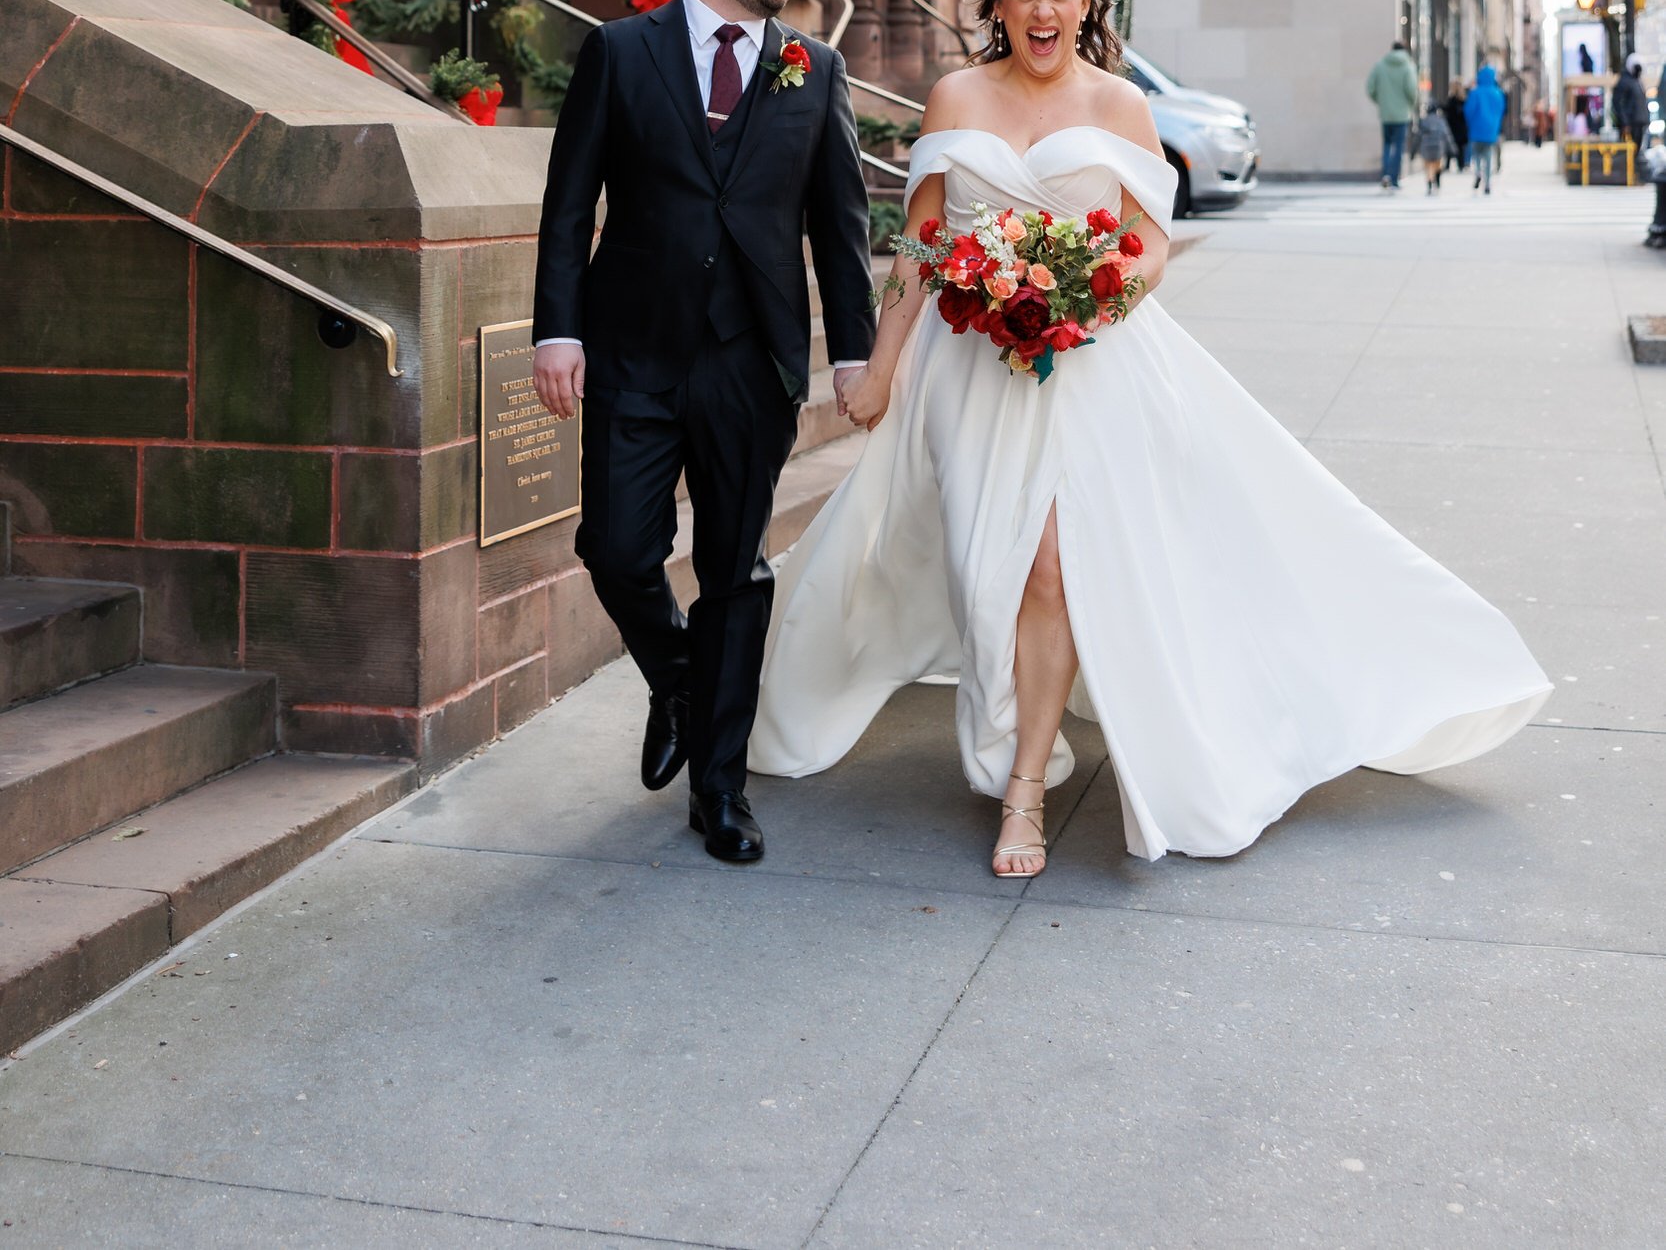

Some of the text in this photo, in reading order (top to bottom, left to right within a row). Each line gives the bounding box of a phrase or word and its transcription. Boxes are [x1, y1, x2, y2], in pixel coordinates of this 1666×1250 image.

[508, 391, 539, 405] THE ENSLAVE
[489, 429, 502, 440] THAT
[503, 425, 516, 437] MADE
[517, 419, 538, 433] POSSIBLE
[538, 417, 548, 427] THE
[537, 429, 555, 442] CHURCH
